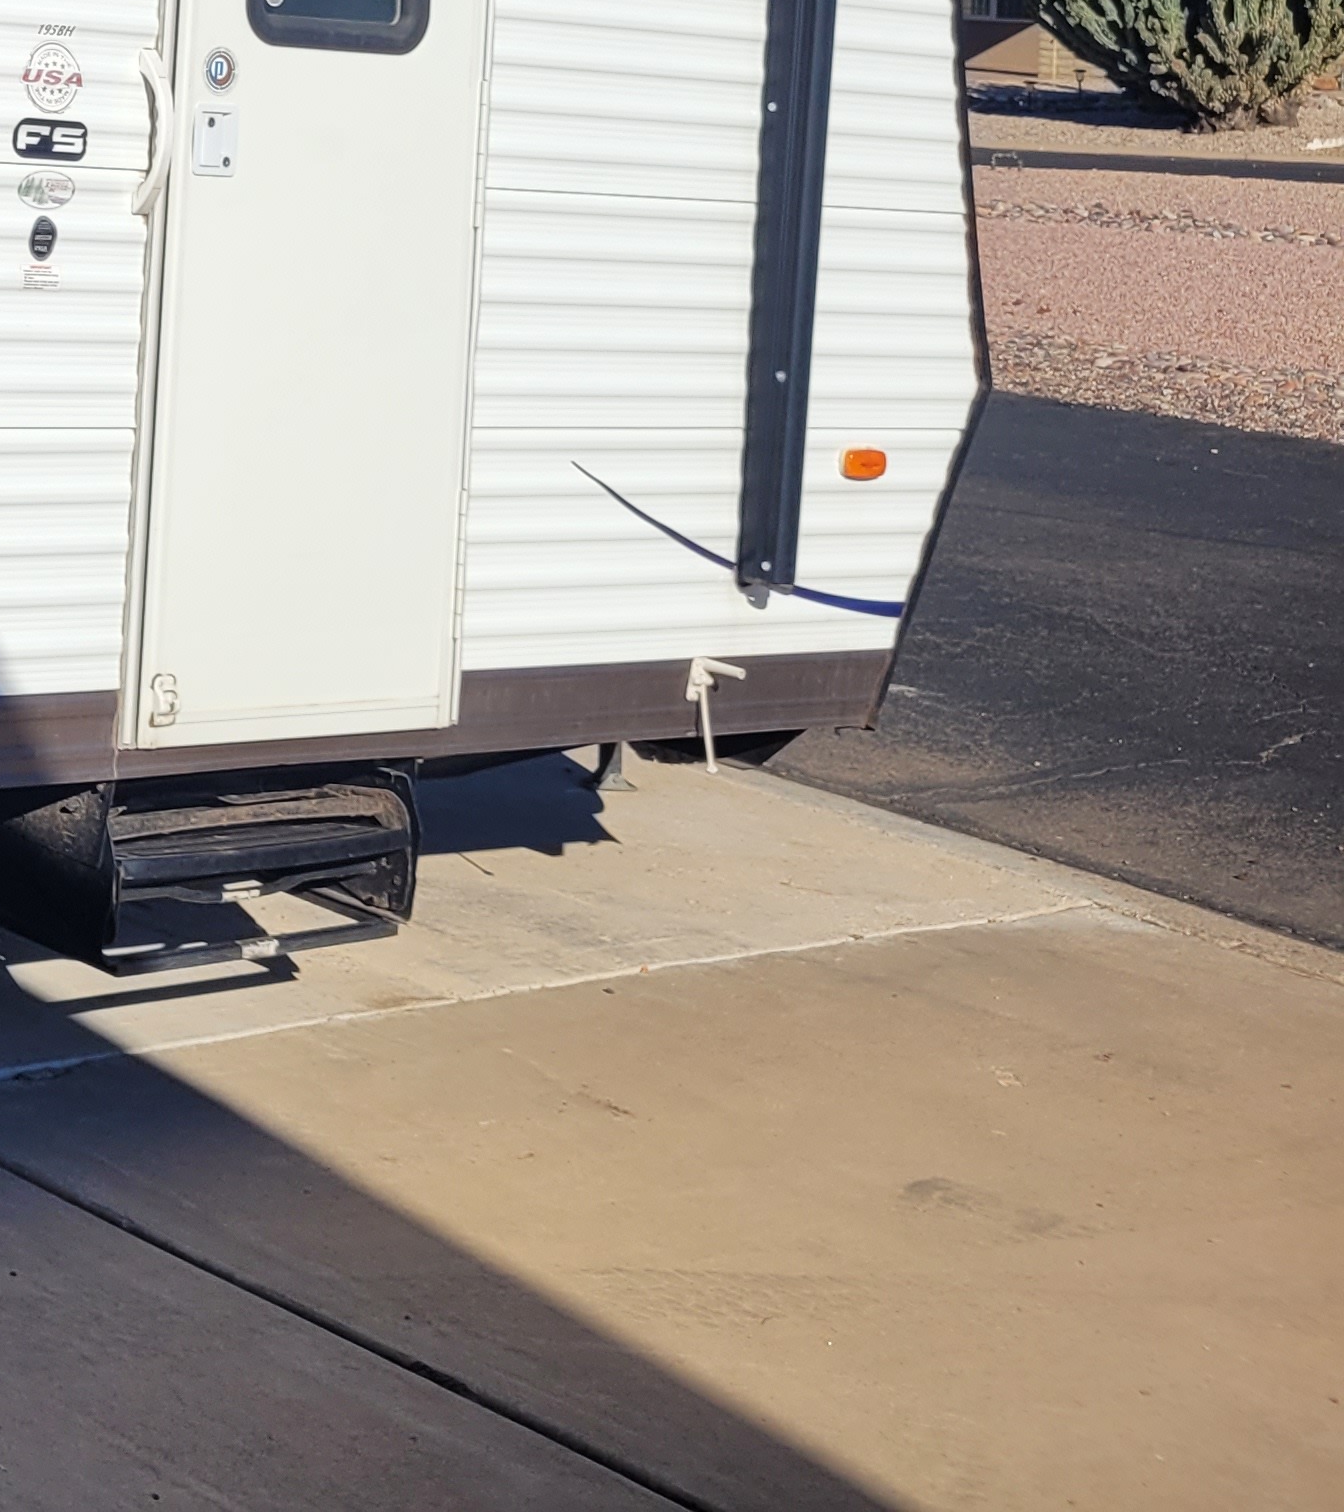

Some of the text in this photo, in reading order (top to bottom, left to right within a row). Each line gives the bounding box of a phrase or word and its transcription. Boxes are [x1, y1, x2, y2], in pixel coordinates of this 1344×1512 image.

[38, 24, 76, 37] 195BH
[22, 68, 83, 88] USA
[16, 124, 86, 154] FS
